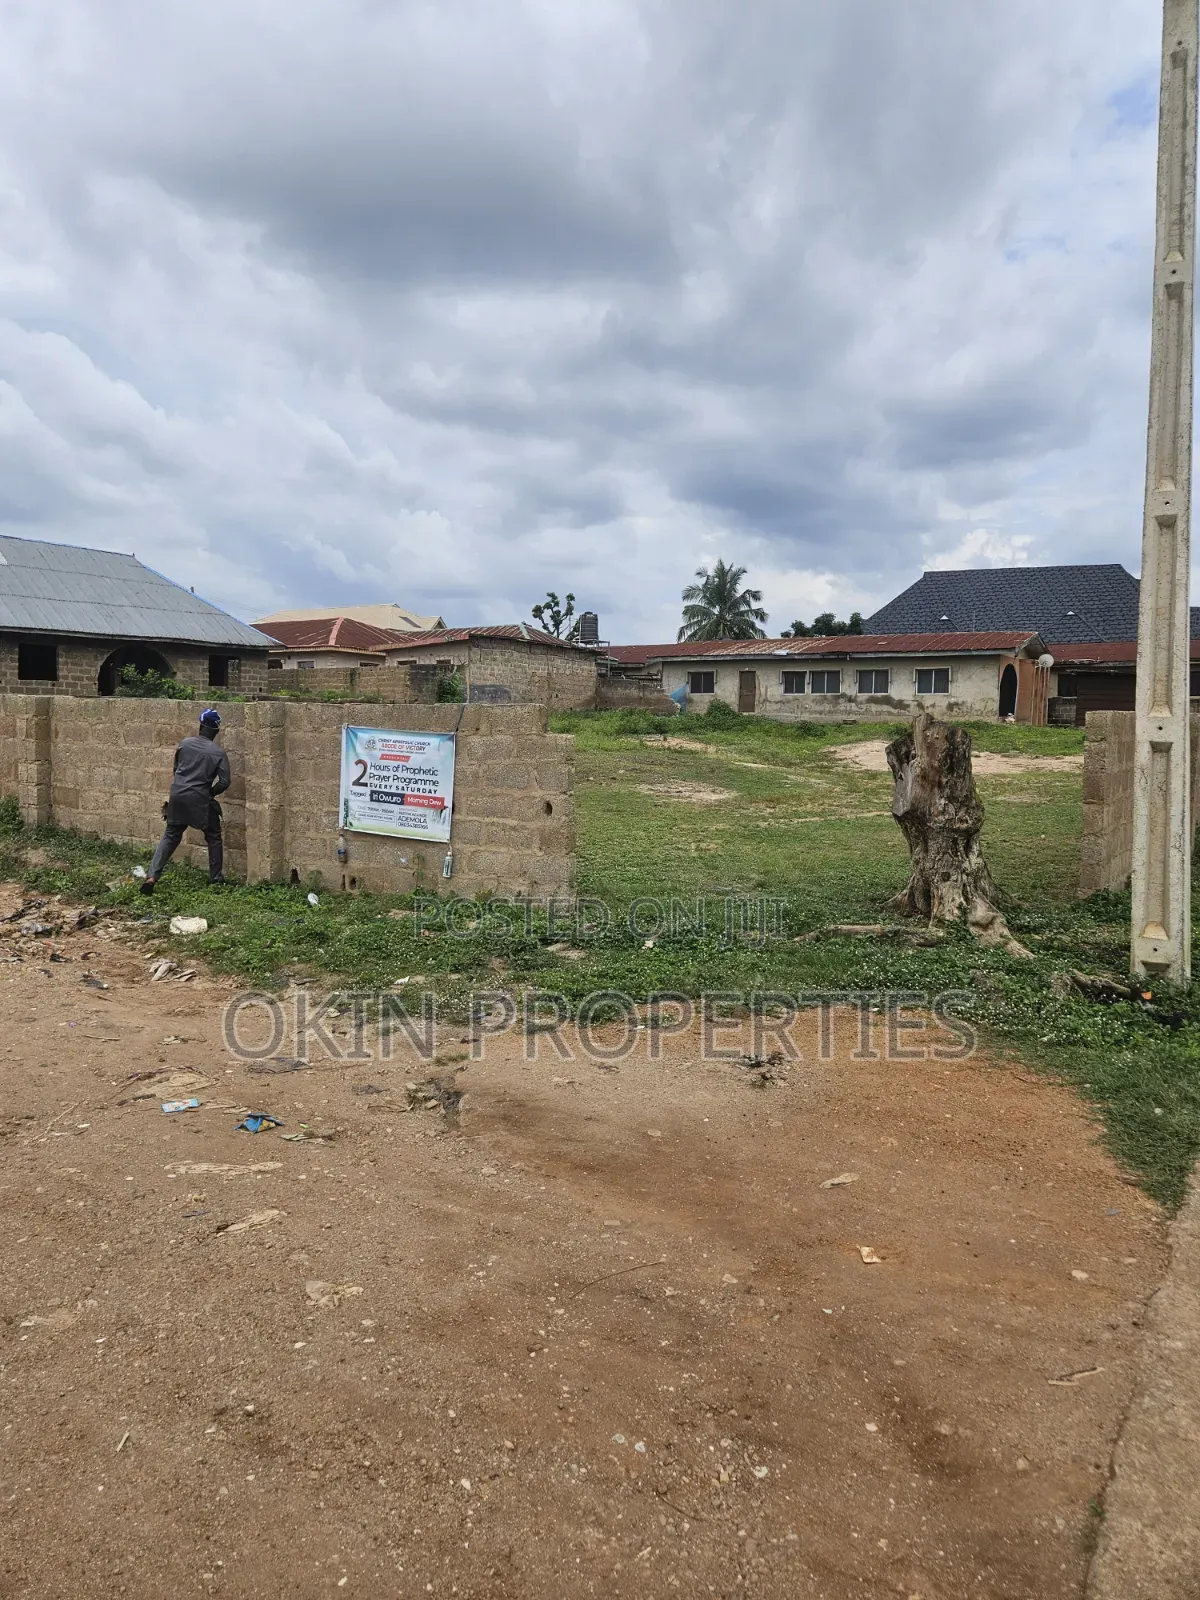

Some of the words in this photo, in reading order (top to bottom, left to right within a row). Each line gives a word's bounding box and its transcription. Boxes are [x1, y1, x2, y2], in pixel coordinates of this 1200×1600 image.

[352, 759, 368, 787] 2
[369, 762, 391, 772] Hours
[392, 764, 400, 773] of
[401, 765, 439, 777] Prophetic
[368, 772, 391, 783] Prayer
[392, 774, 440, 787] Programme
[369, 782, 393, 790] EVERY
[395, 785, 438, 795] SATURDAY
[407, 796, 429, 806] Morning
[429, 798, 442, 806] Dew
[398, 815, 427, 824] ADEMOLA
